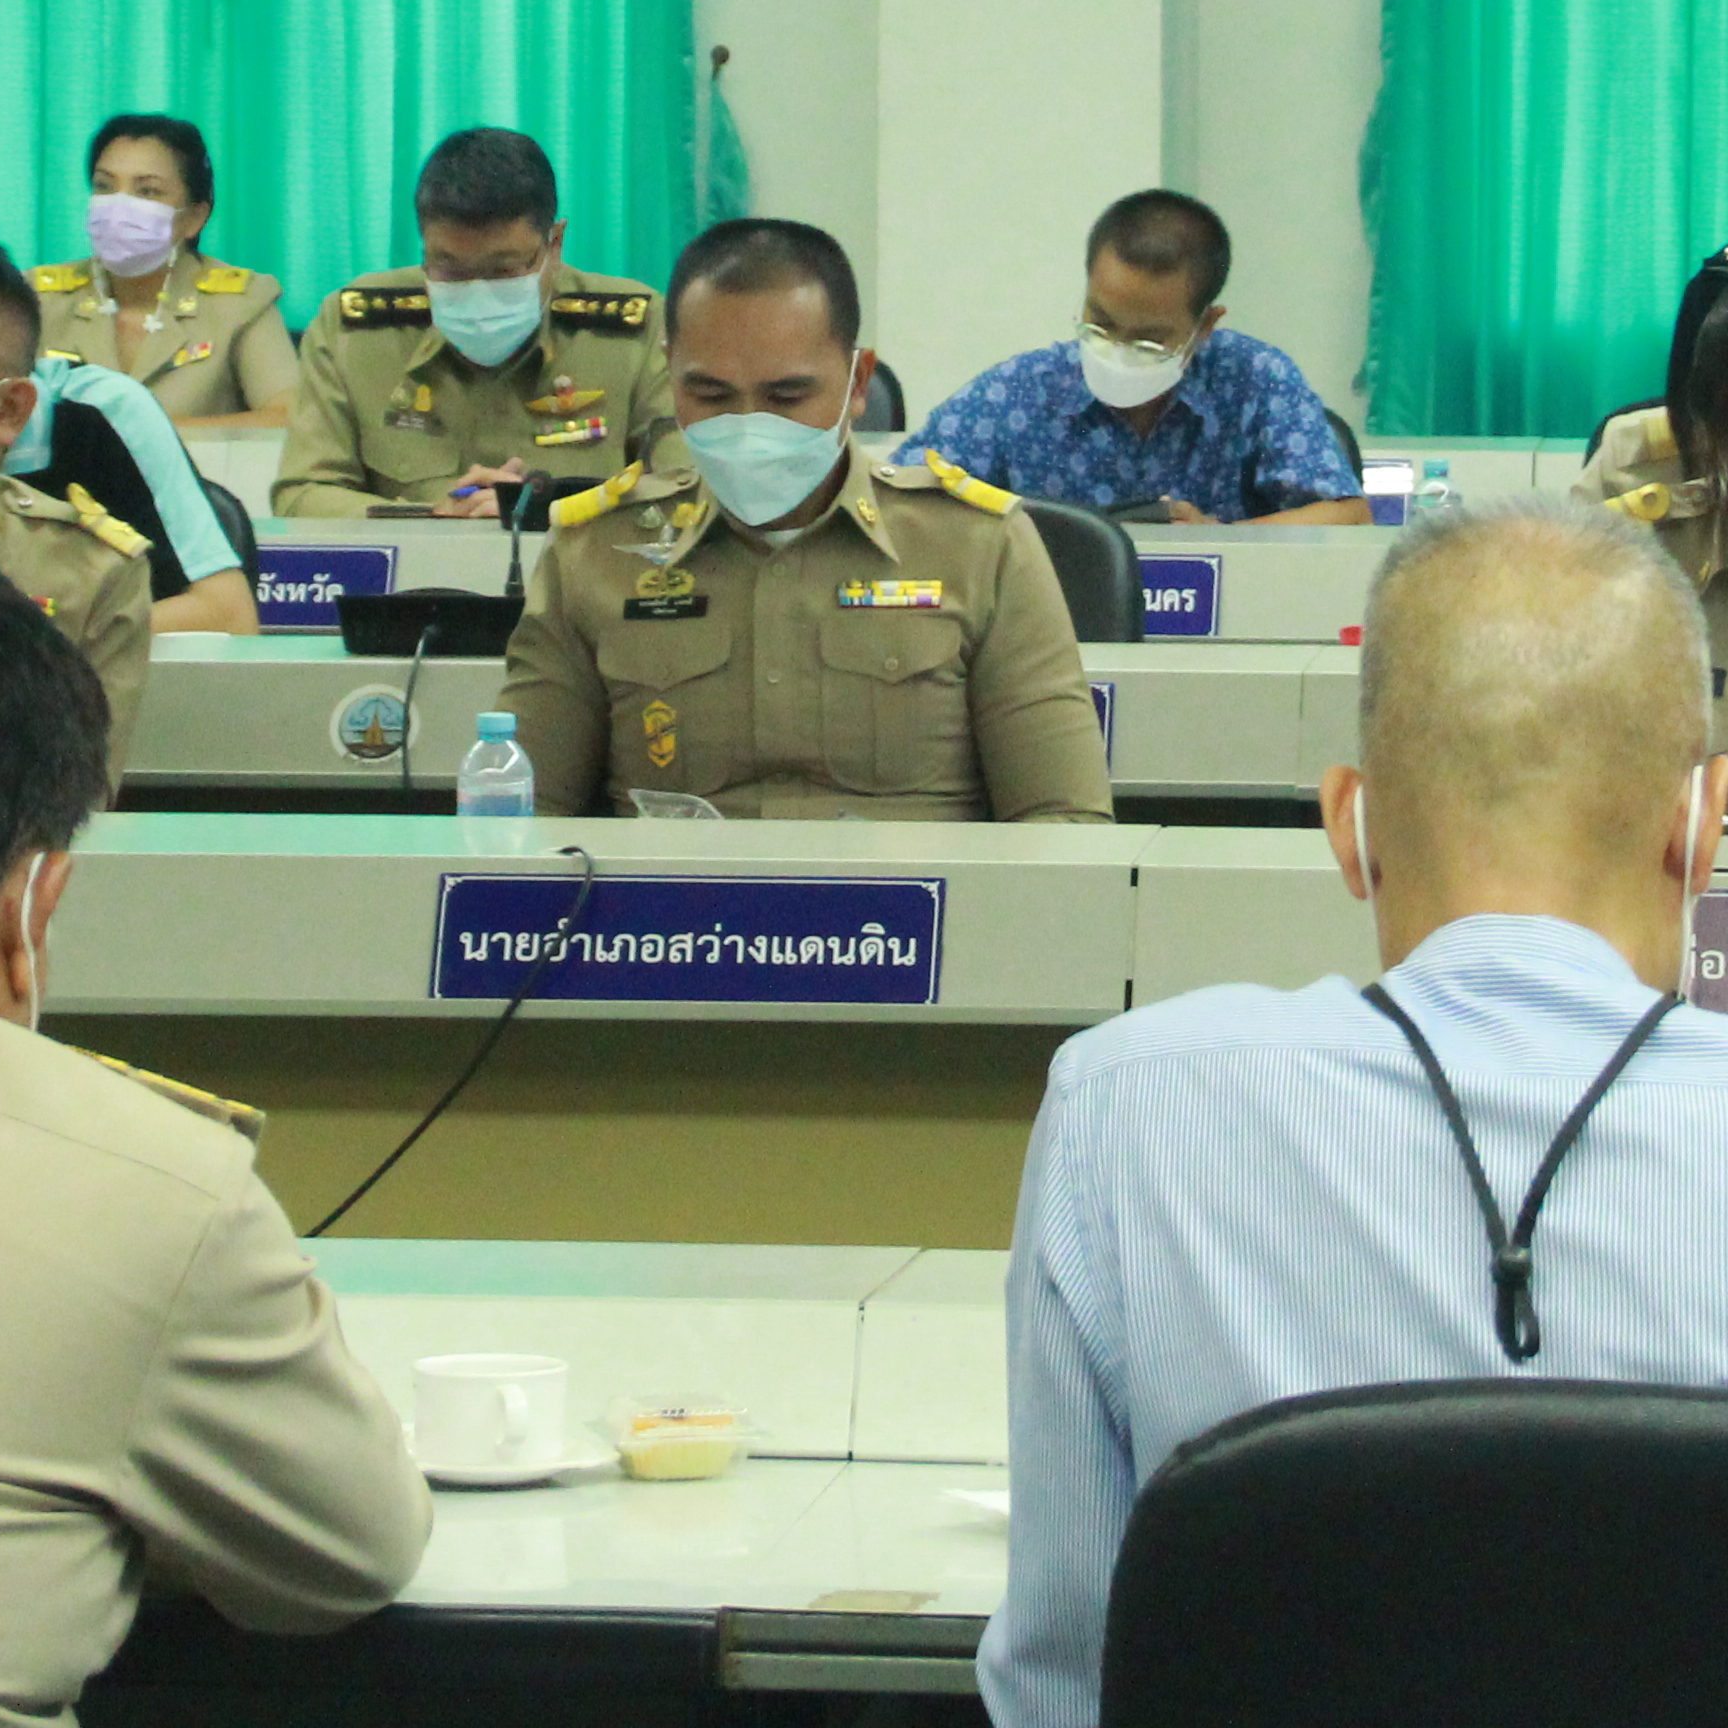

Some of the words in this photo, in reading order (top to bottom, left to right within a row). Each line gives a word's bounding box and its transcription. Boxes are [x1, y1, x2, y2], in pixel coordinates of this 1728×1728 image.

[1142, 588, 1197, 613] นคร
[459, 916, 918, 967] นายอำเภอสว่างแดนดิน
